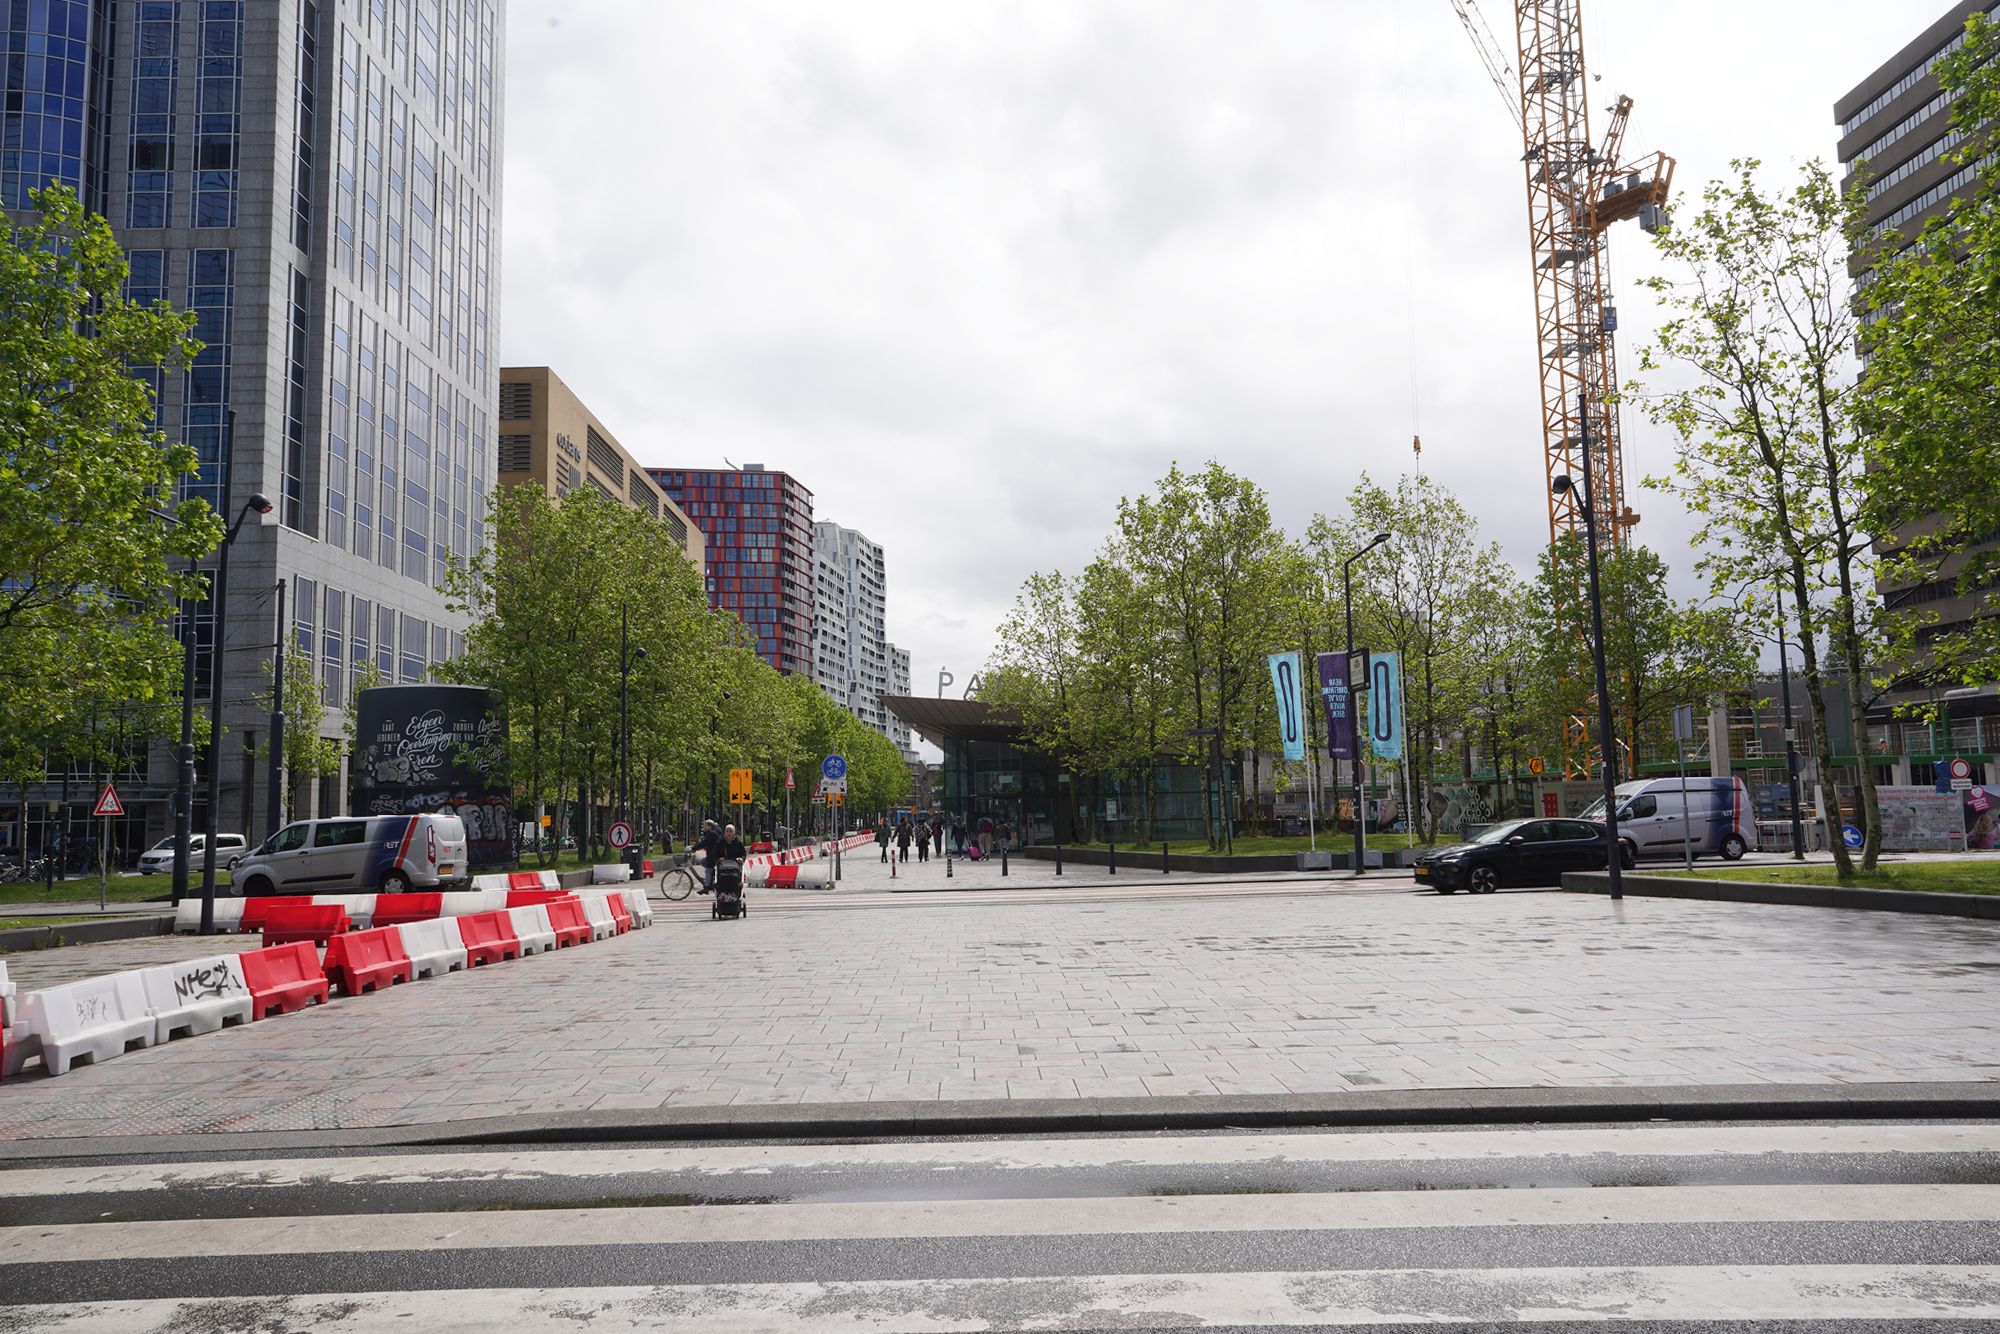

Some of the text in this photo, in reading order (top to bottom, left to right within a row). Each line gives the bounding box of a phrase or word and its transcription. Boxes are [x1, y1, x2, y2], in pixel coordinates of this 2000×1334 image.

[938, 671, 984, 700] PA
[382, 722, 395, 732] LAAT
[406, 709, 446, 740] Eigen
[453, 722, 474, 732] ZONDER
[377, 732, 401, 743] IEDEREEN
[397, 727, 452, 757] Overtuiging
[464, 732, 474, 742] VAN
[408, 753, 444, 769] Eren
[384, 841, 400, 849] RET
